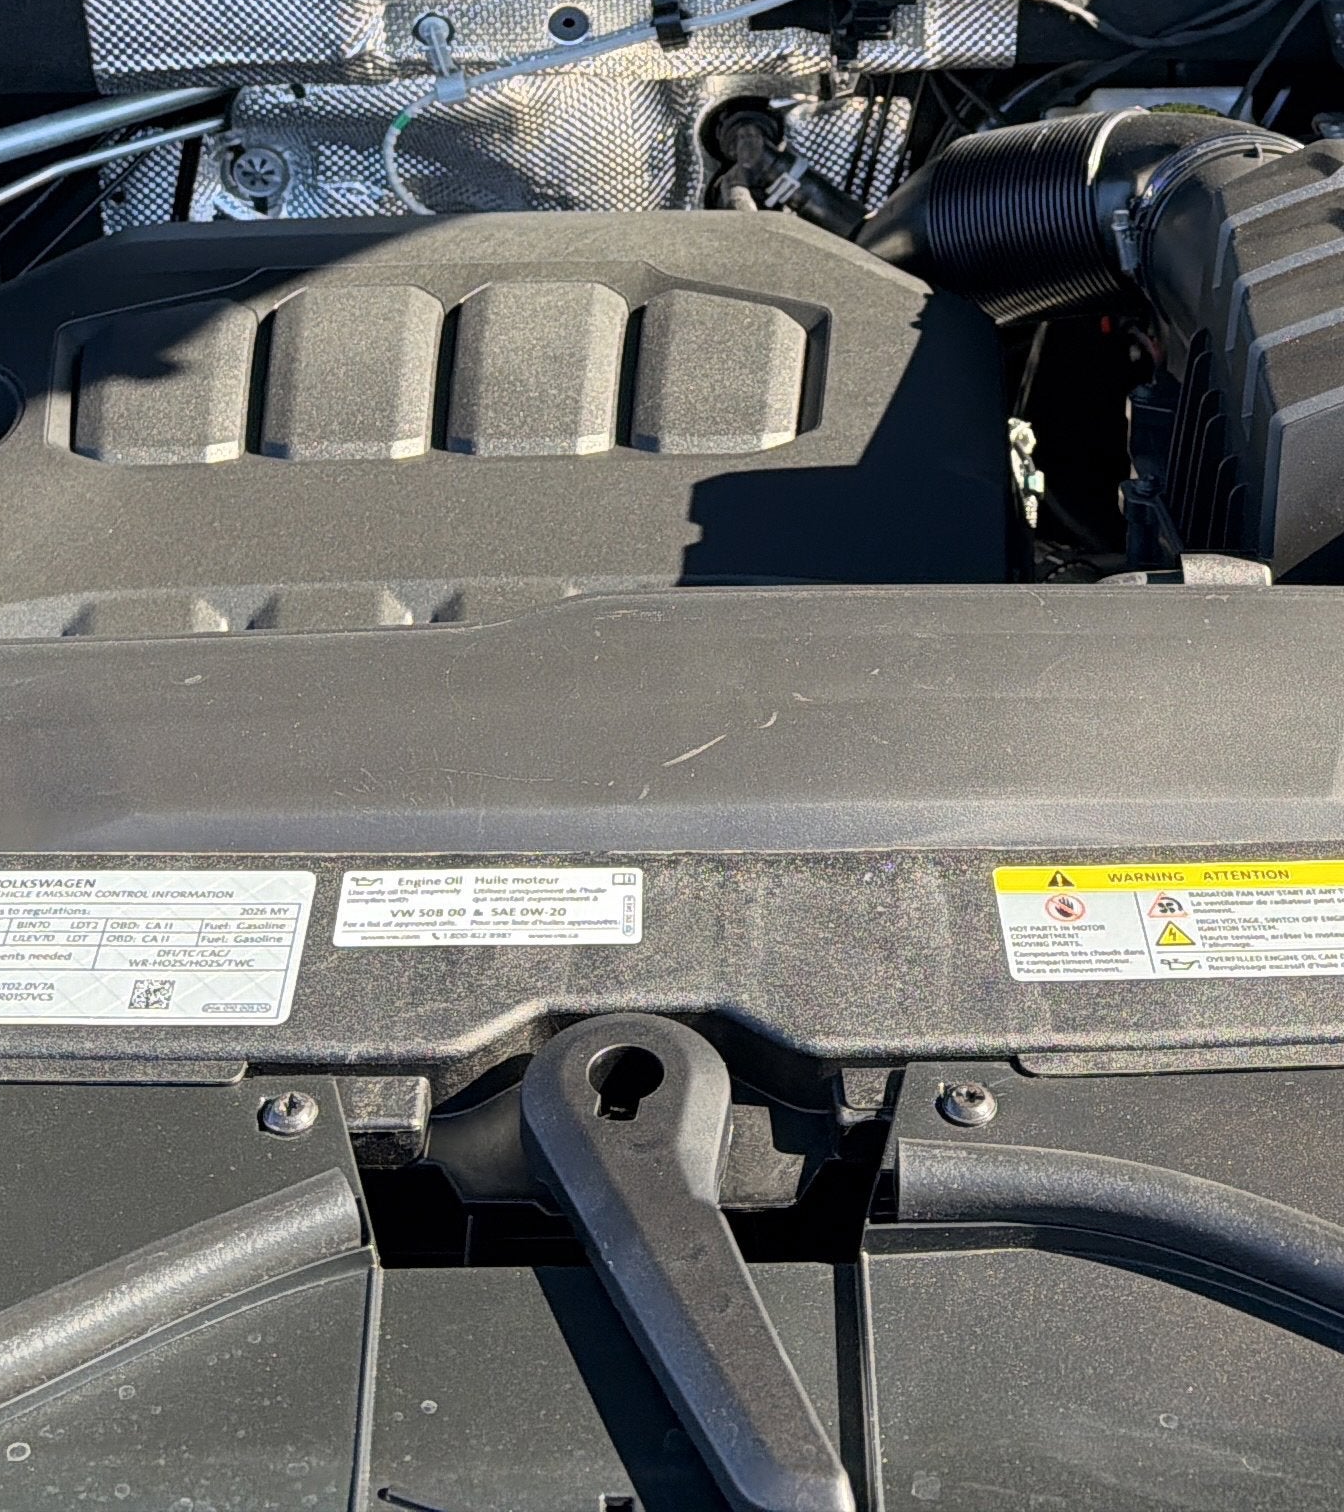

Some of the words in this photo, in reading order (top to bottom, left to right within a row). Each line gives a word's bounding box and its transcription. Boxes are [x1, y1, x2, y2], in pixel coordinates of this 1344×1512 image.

[1106, 871, 1185, 883] WARNING
[1203, 869, 1290, 882] ATTENTION
[398, 876, 442, 888] Engine
[444, 876, 463, 886] Oil
[474, 876, 508, 886] Huile
[512, 876, 560, 886] moteur
[35, 890, 92, 899] EMISSION
[94, 890, 148, 899] CONTROL
[151, 890, 235, 899] INFORMATION
[8, 908, 20, 916] to
[239, 907, 267, 917] 2026
[269, 907, 290, 917] MY
[390, 908, 416, 918] VW
[418, 908, 444, 918] 508
[473, 908, 484, 917] &
[491, 908, 517, 917] SAE
[520, 908, 567, 917] 0W-20
[16, 921, 51, 930] BIN70
[70, 921, 98, 930] LDT2
[145, 922, 163, 930] CA
[236, 922, 286, 930] Gasoline
[1072, 924, 1106, 932] MOTOR
[66, 934, 89, 942] LDT
[141, 935, 159, 943] CA
[233, 935, 284, 944] Gasoline
[28, 952, 73, 961] needed
[1014, 950, 1070, 958] Composants
[1026, 958, 1093, 967] compartiment
